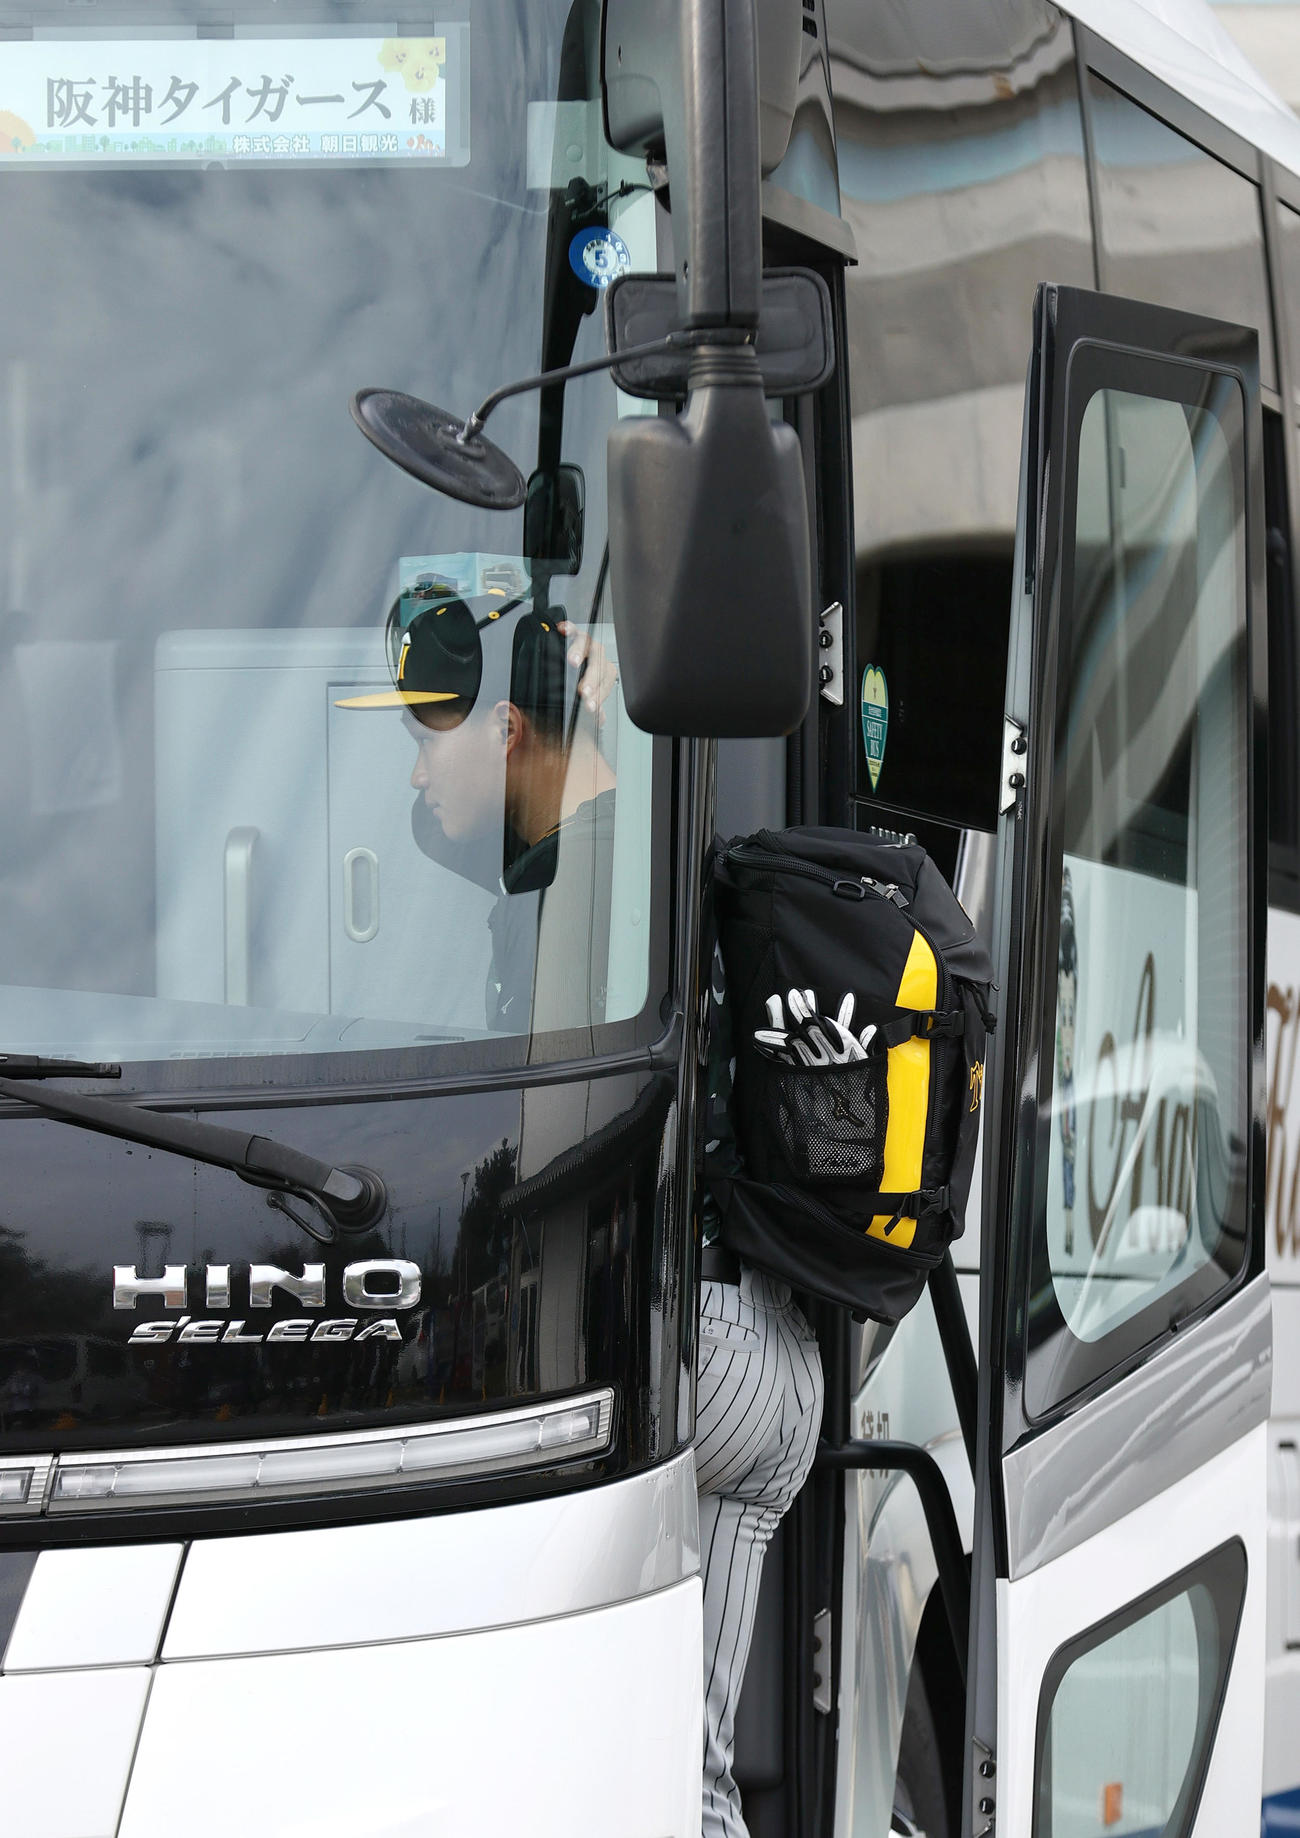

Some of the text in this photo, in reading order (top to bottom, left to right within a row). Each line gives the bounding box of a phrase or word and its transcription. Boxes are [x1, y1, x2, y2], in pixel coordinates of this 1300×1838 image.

[46, 73, 436, 128] 阪神タイガース 様
[233, 134, 399, 154] 株式会社 朝日観光
[595, 250, 608, 267] 5
[867, 720, 882, 739] SAFETY
[870, 740, 879, 757] BUS
[113, 1259, 422, 1310] HINO
